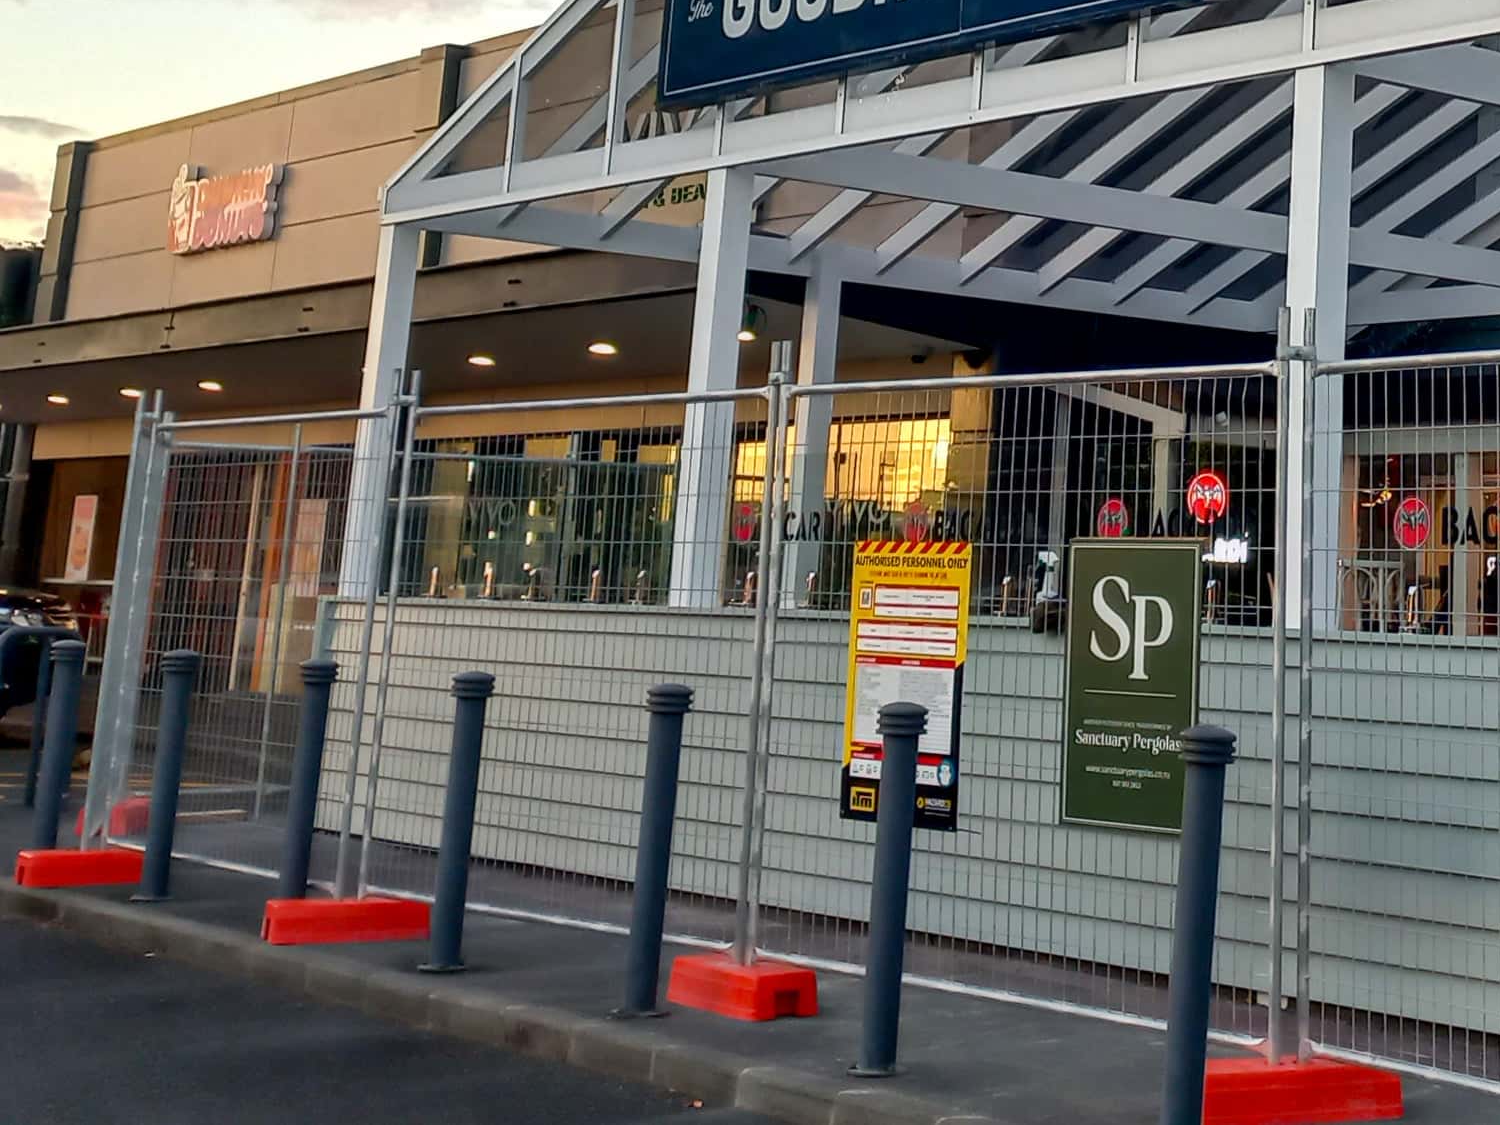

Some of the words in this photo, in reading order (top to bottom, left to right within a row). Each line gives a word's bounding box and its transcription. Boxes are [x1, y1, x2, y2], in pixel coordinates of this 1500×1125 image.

[855, 555, 901, 567] AUTHORISED
[902, 556, 946, 568] PERSONNEL
[947, 558, 969, 569] ONLY
[1089, 575, 1174, 680] SP
[1075, 728, 1131, 752] Sanctuary
[1133, 733, 1184, 755] Pergolas
